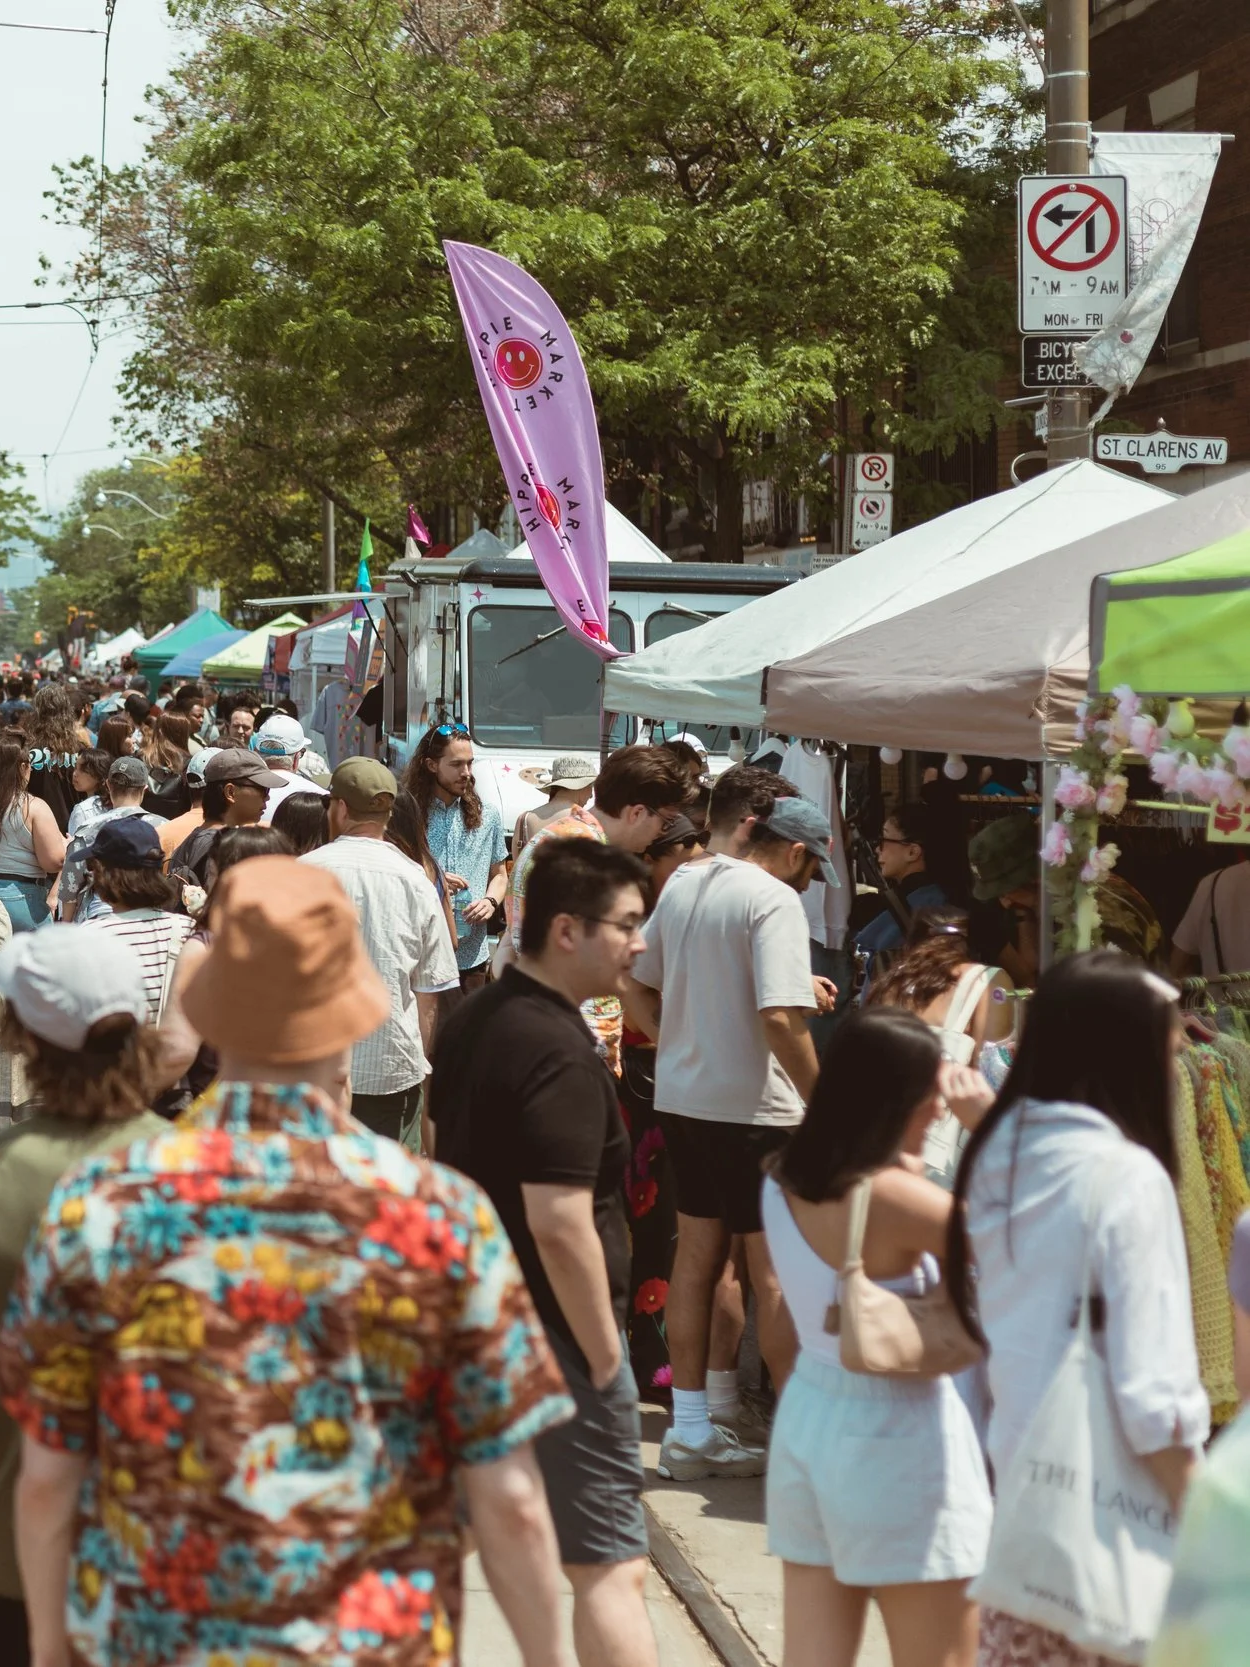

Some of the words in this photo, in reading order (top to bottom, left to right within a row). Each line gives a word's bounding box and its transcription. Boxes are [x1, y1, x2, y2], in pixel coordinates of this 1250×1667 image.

[1044, 313, 1069, 326] MON
[1085, 313, 1103, 326] FRI
[1039, 341, 1072, 358] BICY
[1102, 439, 1121, 456] ST.
[1127, 440, 1198, 459] CLARENS
[1203, 443, 1223, 461] AV.
